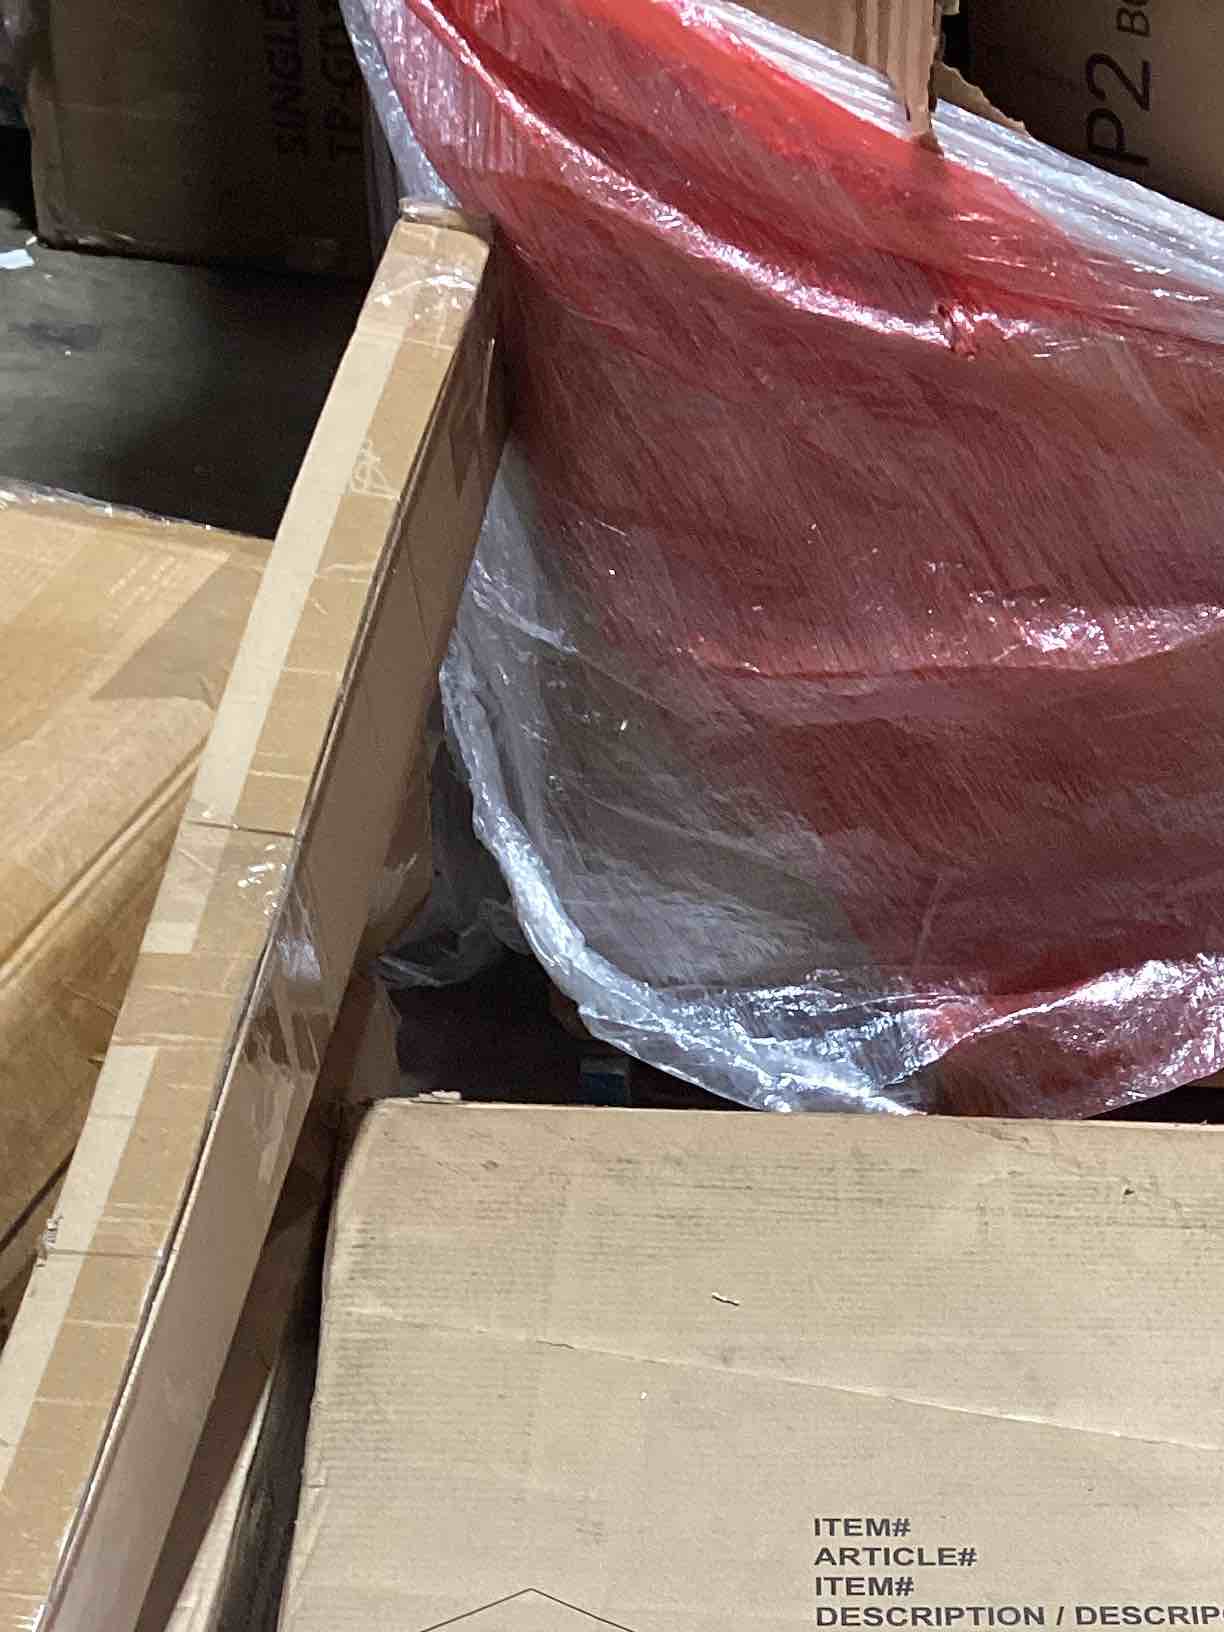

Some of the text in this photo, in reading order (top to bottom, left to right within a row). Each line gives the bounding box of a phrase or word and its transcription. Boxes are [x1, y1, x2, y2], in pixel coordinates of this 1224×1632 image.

[1086, 53, 1150, 166] P2
[814, 1517, 911, 1537] ITEM#
[813, 1547, 977, 1567] ARTICLE#
[815, 1576, 915, 1597] ITEM#
[816, 1606, 1045, 1627] DESCRIPTION
